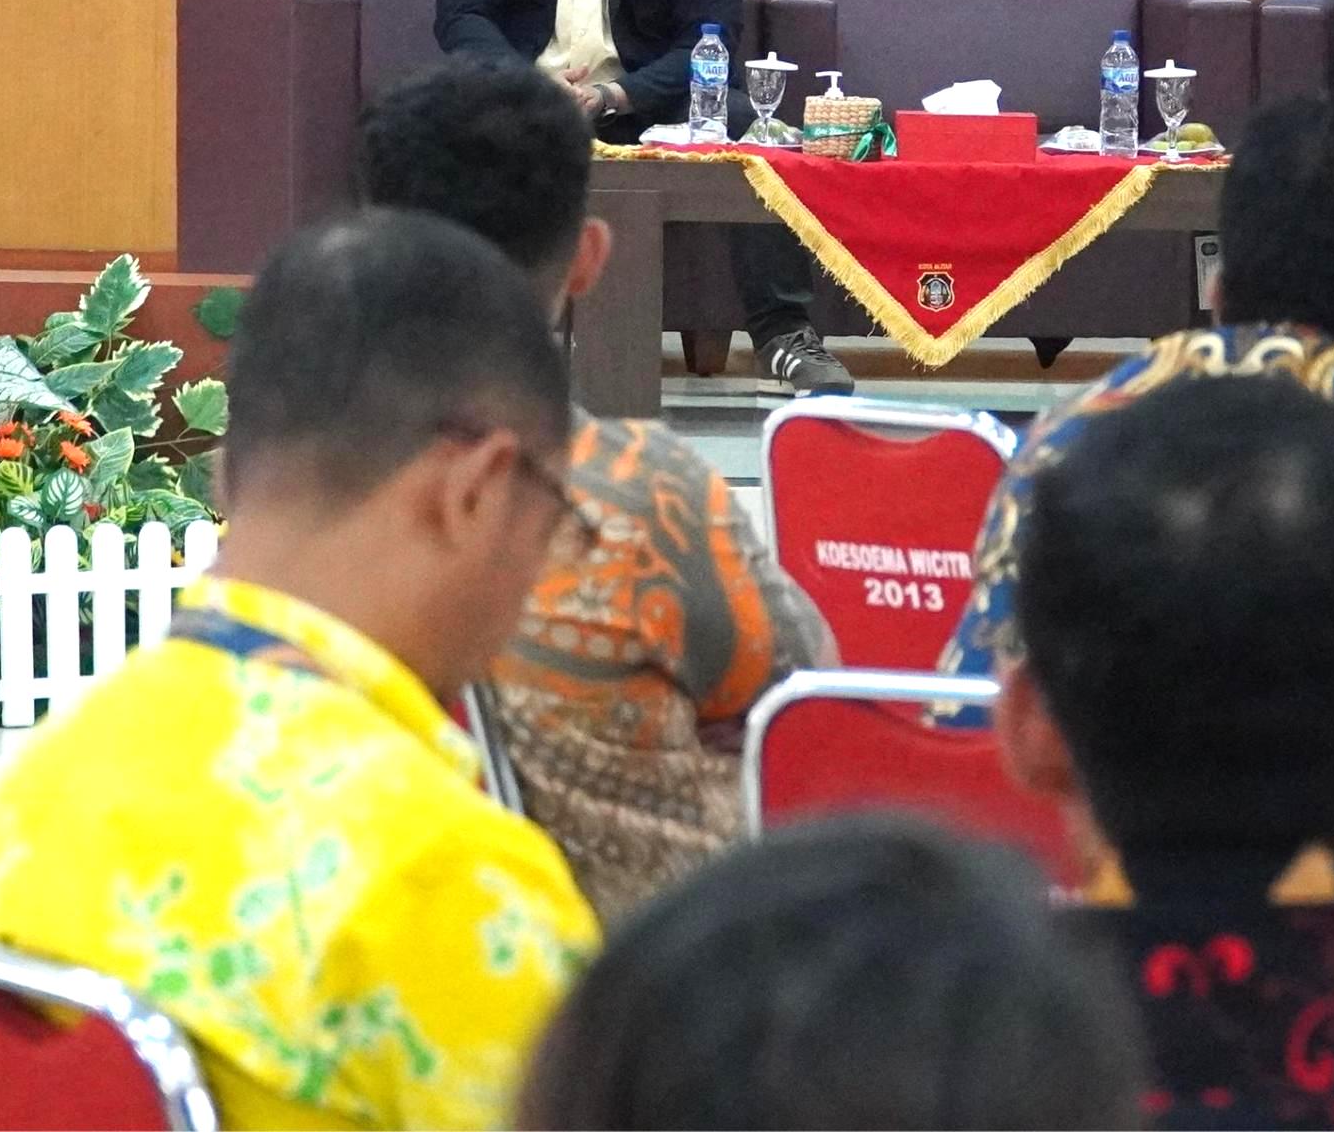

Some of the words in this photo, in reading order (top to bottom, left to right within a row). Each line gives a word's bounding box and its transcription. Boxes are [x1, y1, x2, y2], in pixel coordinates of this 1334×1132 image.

[816, 539, 909, 575] KOESOEMA
[908, 548, 973, 579] WICITR
[863, 576, 945, 612] 2013
